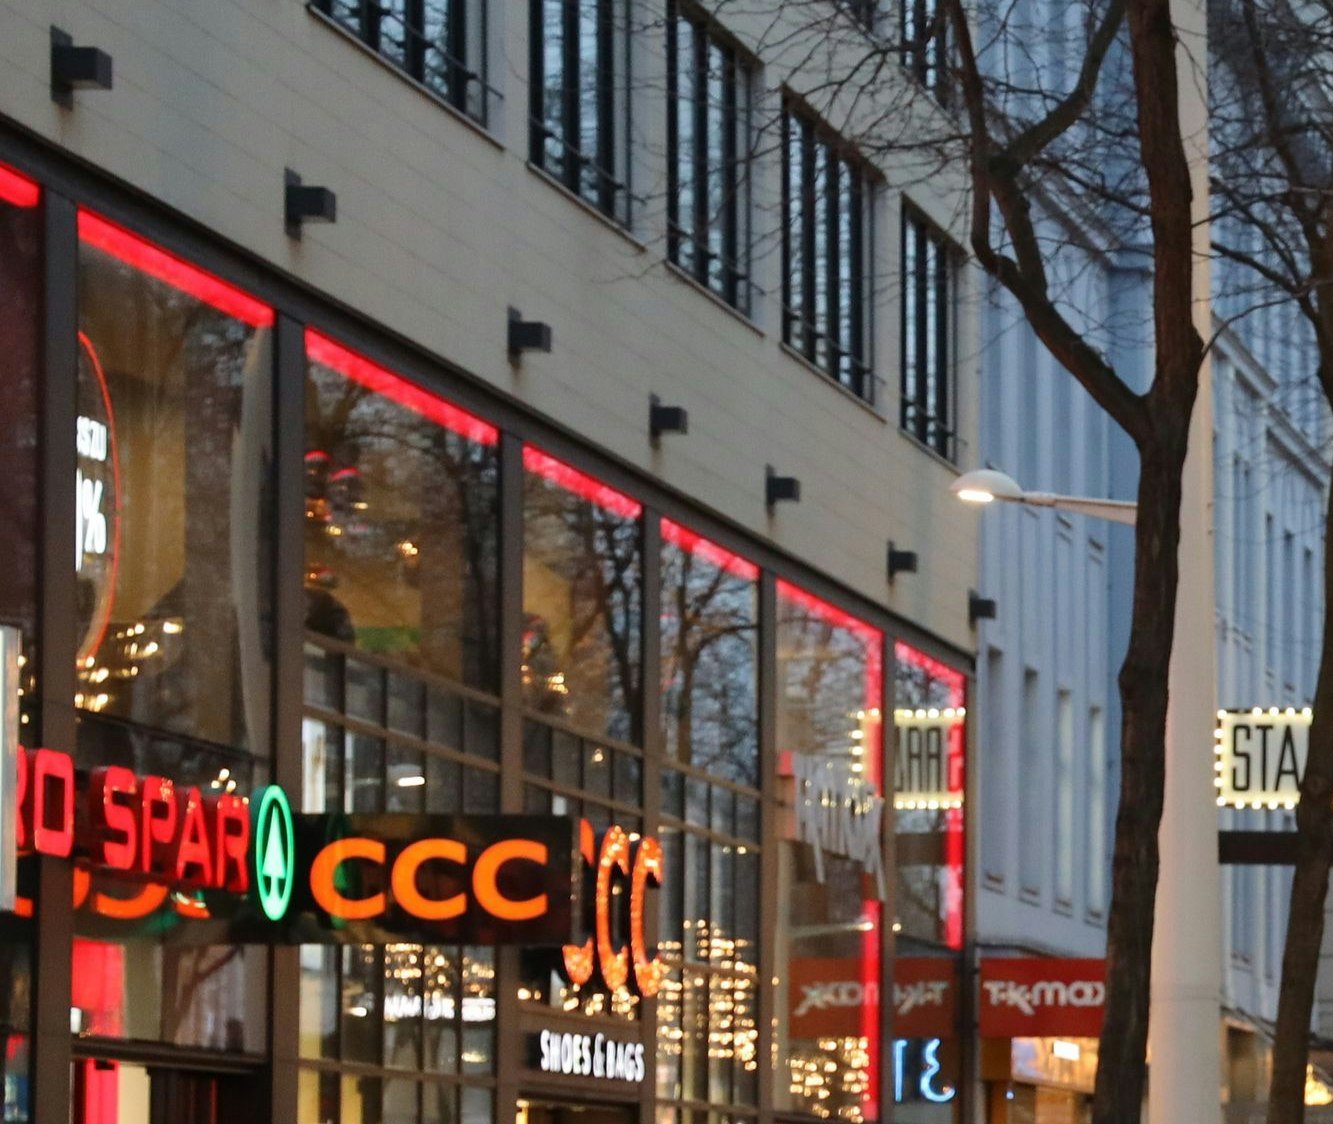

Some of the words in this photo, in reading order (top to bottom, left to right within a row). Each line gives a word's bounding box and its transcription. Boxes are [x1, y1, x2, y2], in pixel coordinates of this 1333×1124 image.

[103, 765, 251, 893] SPAR
[310, 837, 549, 921] CCC
[541, 1030, 591, 1075] SHOES
[606, 1040, 645, 1082] BAGS
